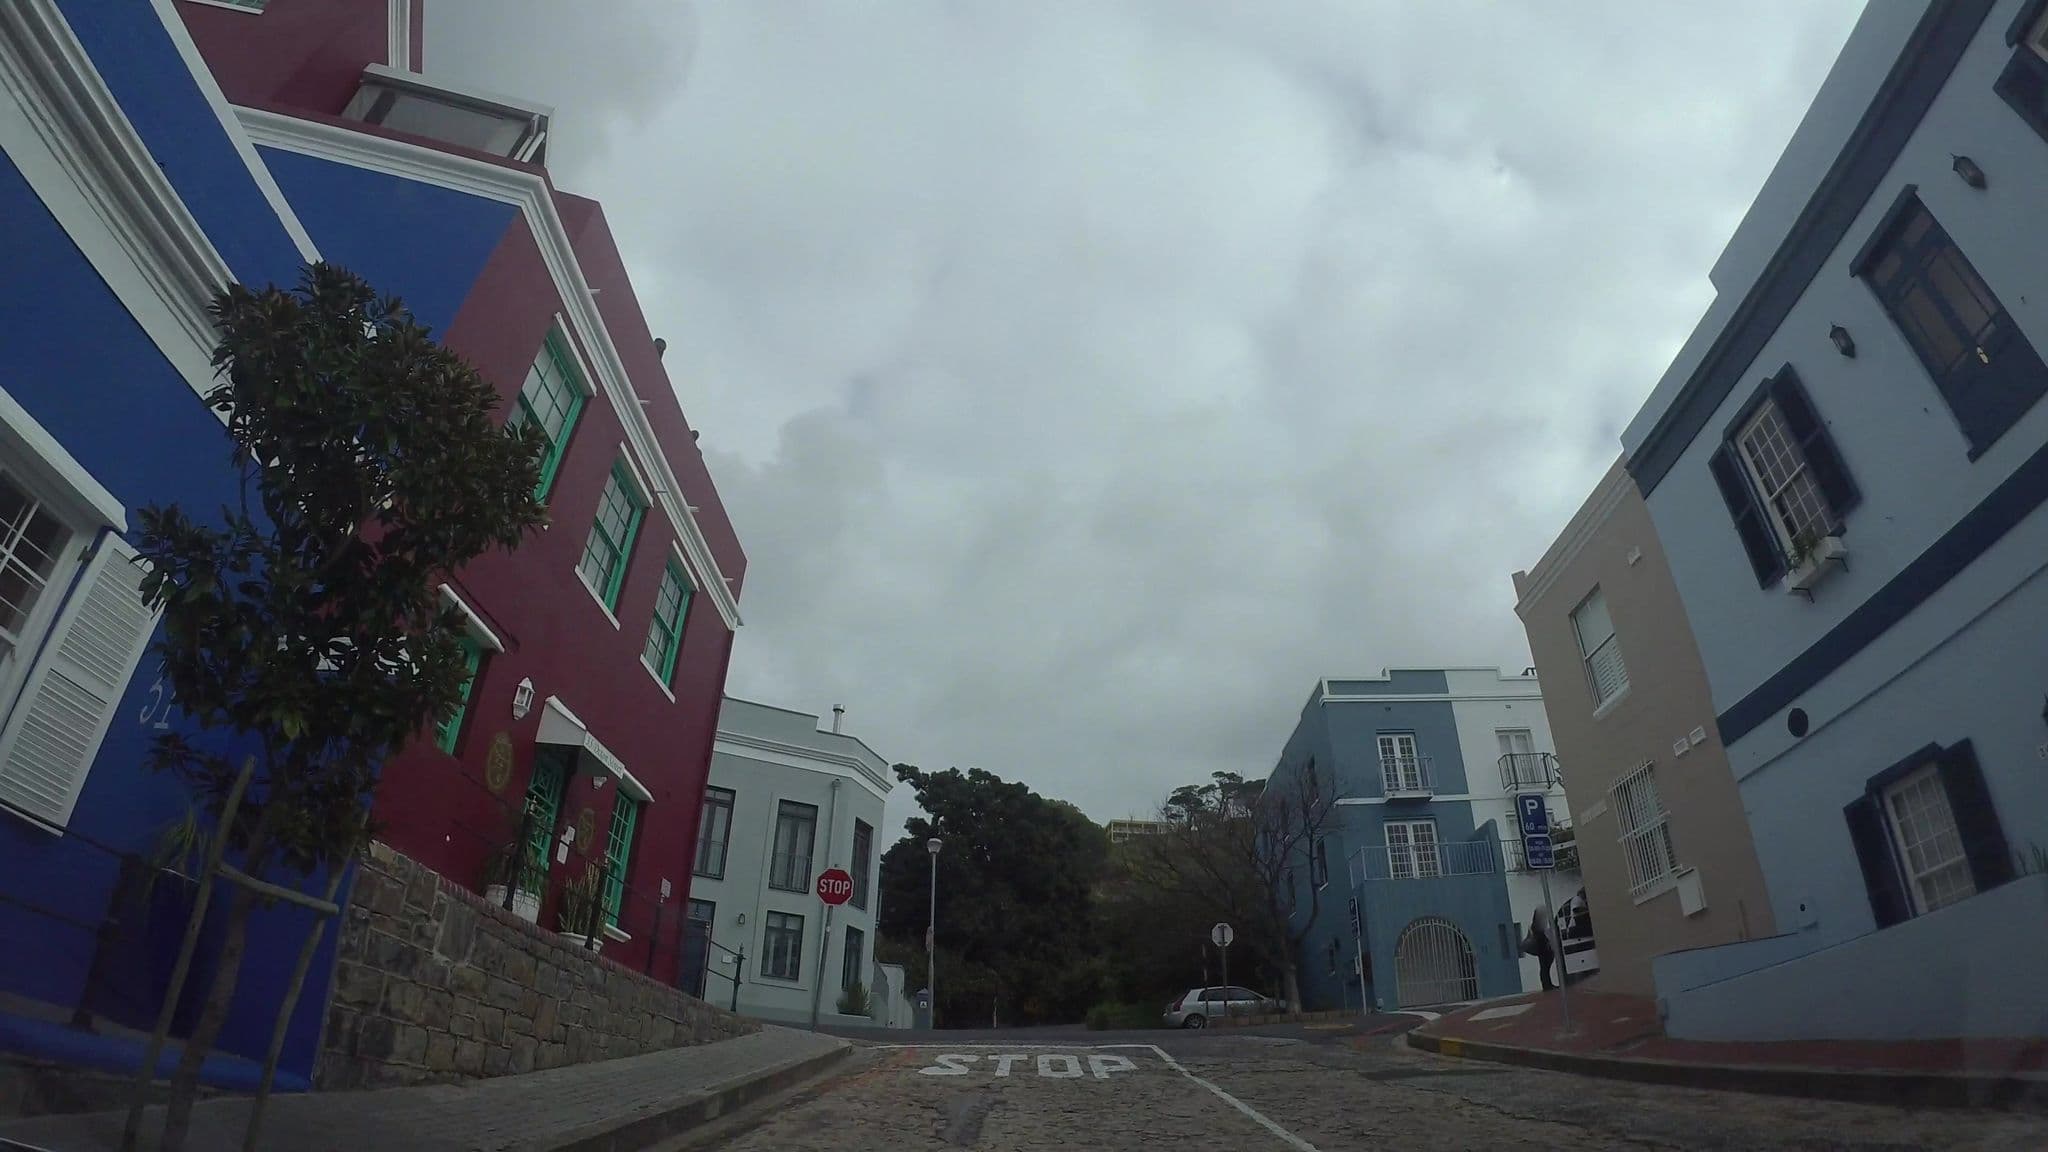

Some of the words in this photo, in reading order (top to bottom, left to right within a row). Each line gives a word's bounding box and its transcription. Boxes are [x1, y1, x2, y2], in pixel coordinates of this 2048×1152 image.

[1525, 799, 1538, 815] P
[1525, 822, 1535, 831] 60
[819, 878, 850, 896] STOP
[918, 1053, 1139, 1080] STOP
